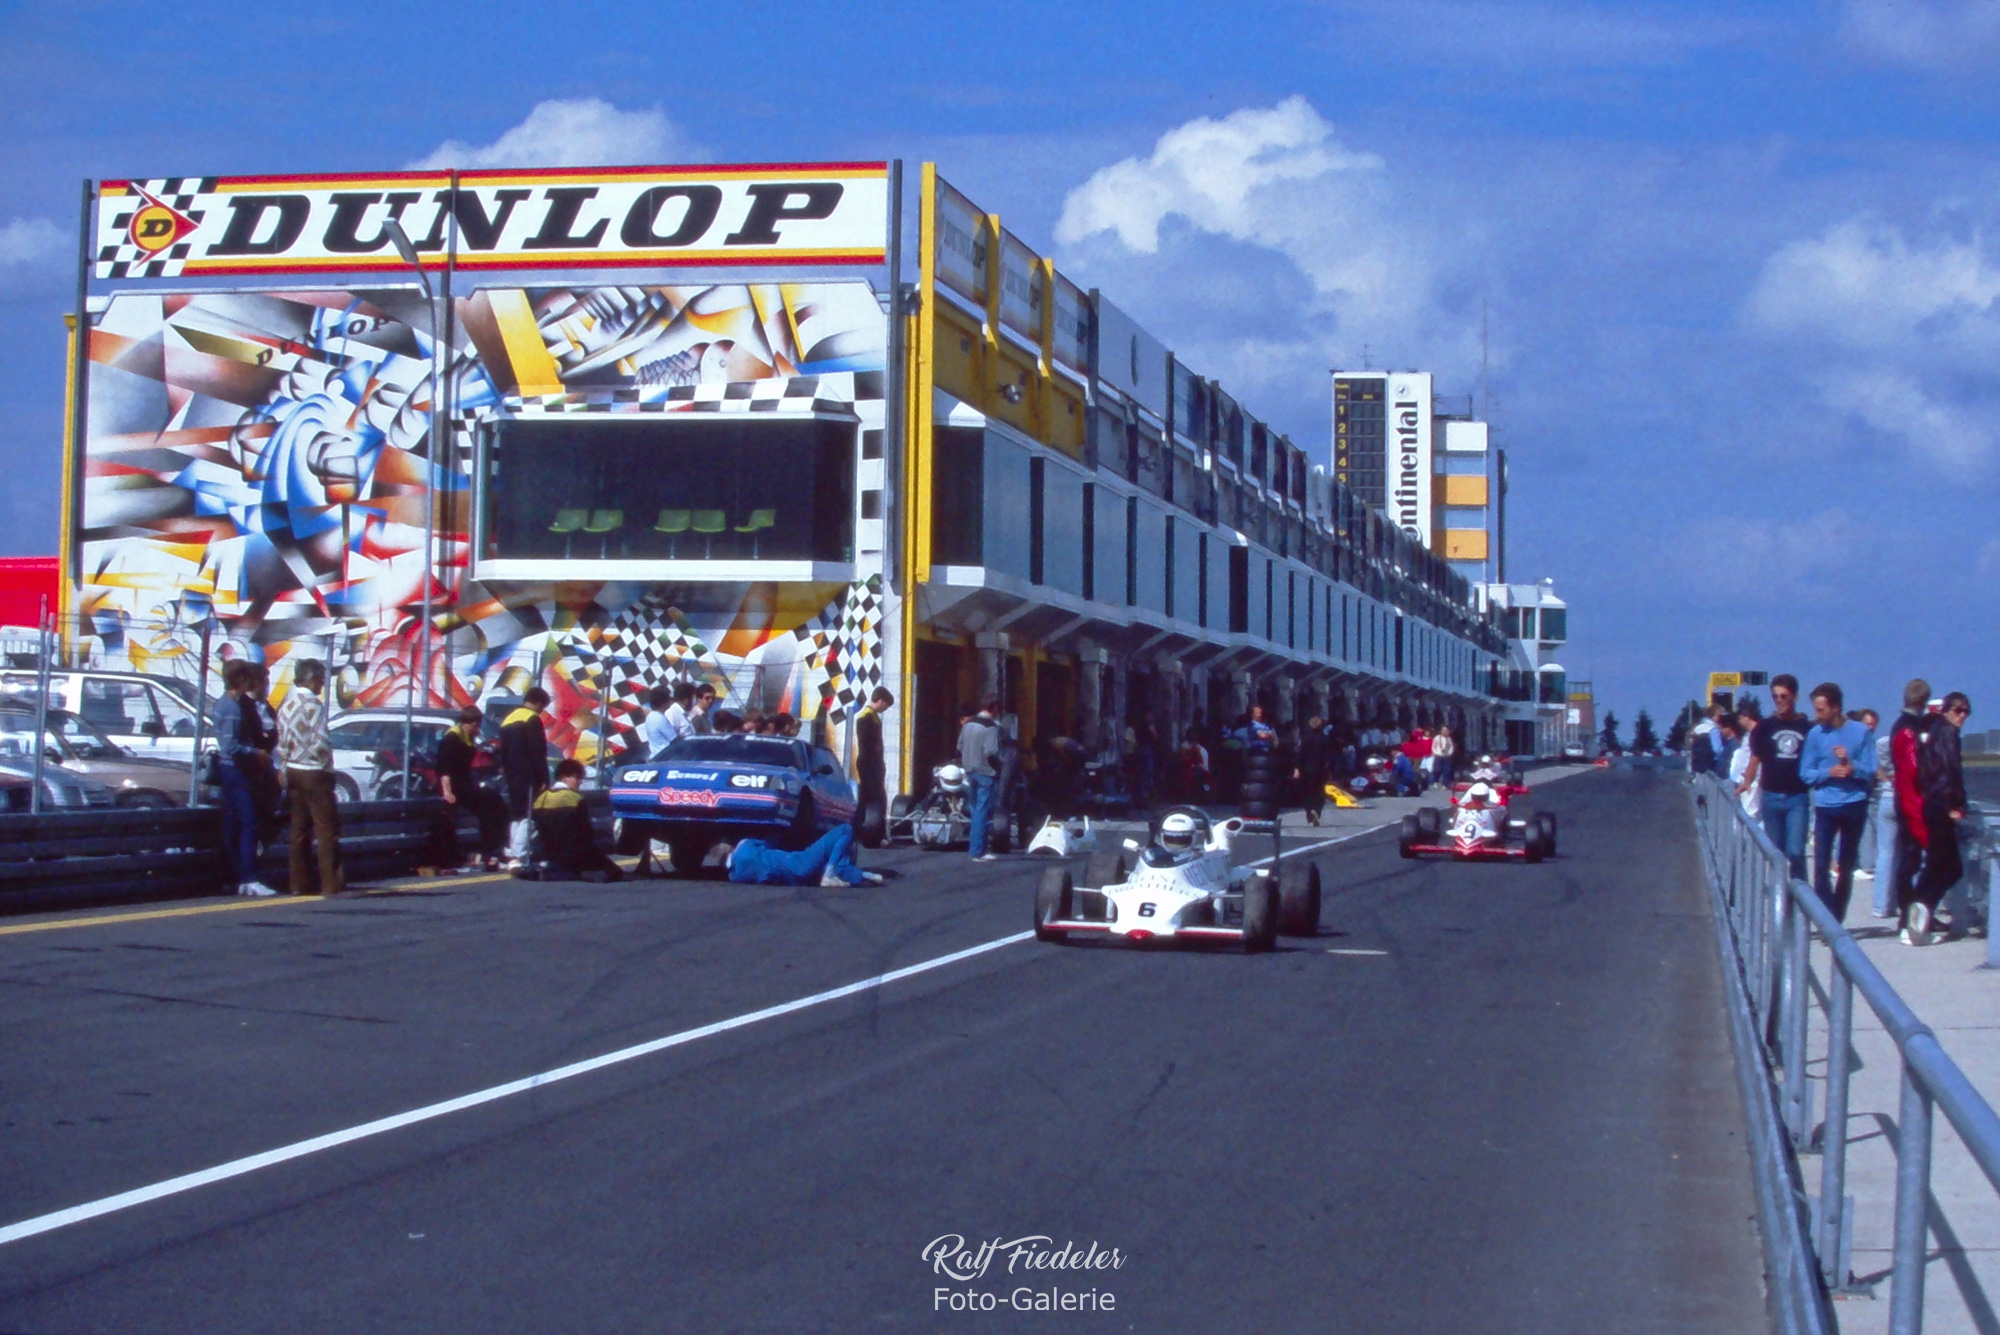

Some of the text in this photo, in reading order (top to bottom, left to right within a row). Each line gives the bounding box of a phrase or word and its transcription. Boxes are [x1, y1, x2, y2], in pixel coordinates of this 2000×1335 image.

[205, 182, 844, 256] DUNLOP
[256, 316, 390, 367] DUNLOP
[1338, 404, 1345, 415] 1
[1338, 422, 1346, 433] 2
[1338, 439, 1346, 450] 3
[1338, 456, 1347, 467] 4
[623, 770, 658, 783] elf
[731, 775, 768, 788] elf
[658, 786, 719, 806] Speedy
[1464, 823, 1477, 840] 9
[1137, 902, 1157, 918] 6
